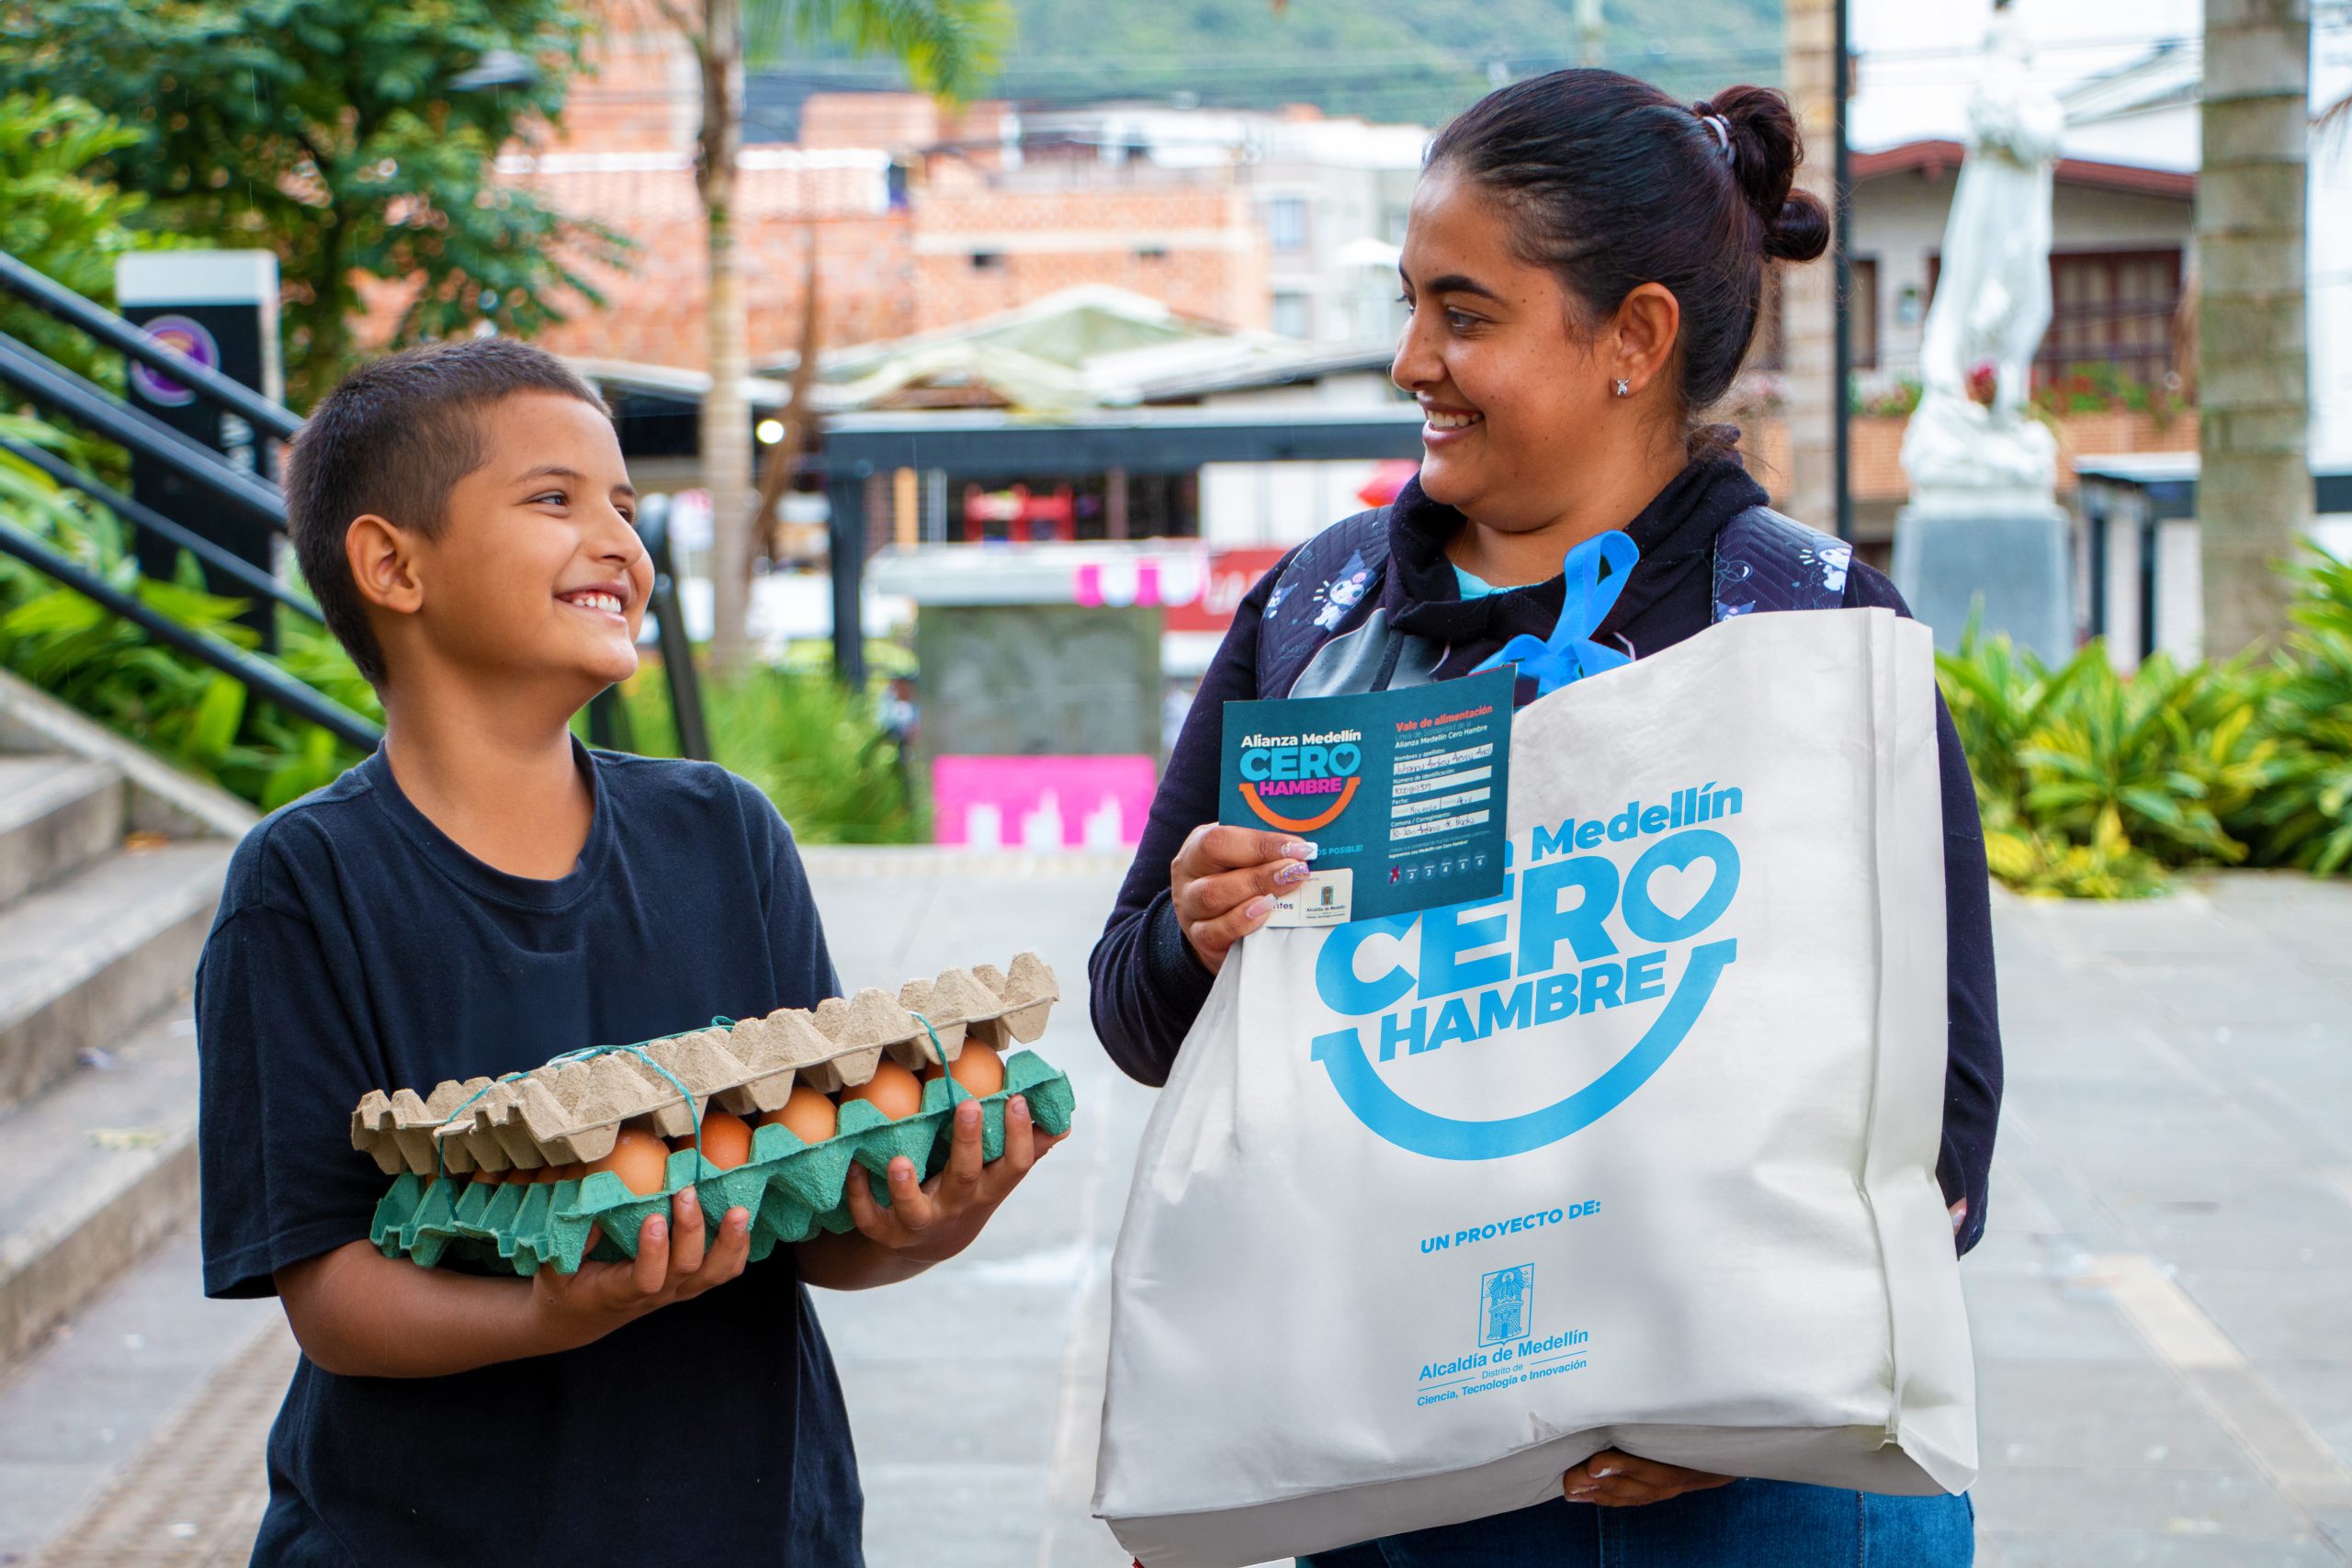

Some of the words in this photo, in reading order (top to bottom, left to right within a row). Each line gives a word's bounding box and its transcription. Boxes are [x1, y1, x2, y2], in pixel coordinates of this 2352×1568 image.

[1396, 720, 1418, 732] Vale
[1420, 717, 1432, 728] de
[1434, 705, 1493, 725] alimentación
[1241, 734, 1298, 748] Alianza
[1303, 728, 1362, 745] Medellín
[1396, 739, 1419, 749] Alianza
[1464, 725, 1487, 735] Hambre
[1239, 743, 1361, 781] CERO
[1395, 752, 1418, 761] Nombres
[1260, 777, 1342, 796] HAMBRE
[1393, 775, 1414, 784] Número
[1392, 797, 1408, 806] Fecha:
[1390, 818, 1411, 828] Comuna
[1532, 781, 1743, 862] Medellín
[1273, 901, 1294, 909] ntes
[1315, 829, 1741, 1015] CERO
[1378, 949, 1668, 1063] HAMBRE
[1420, 1235, 1450, 1254] UN
[1455, 1208, 1563, 1247] PROYECTO
[1568, 1200, 1601, 1220] DE:
[1419, 1353, 1487, 1382] Alcaldía
[1492, 1347, 1513, 1363] de
[1518, 1330, 1589, 1358] Medellín
[1417, 1389, 1458, 1406] Ciencia,
[1462, 1373, 1518, 1396] Tecnología
[1520, 1373, 1528, 1382] e
[1530, 1359, 1587, 1381] Innovación
[1482, 1365, 1511, 1380] Distrito
[1512, 1363, 1523, 1373] de
